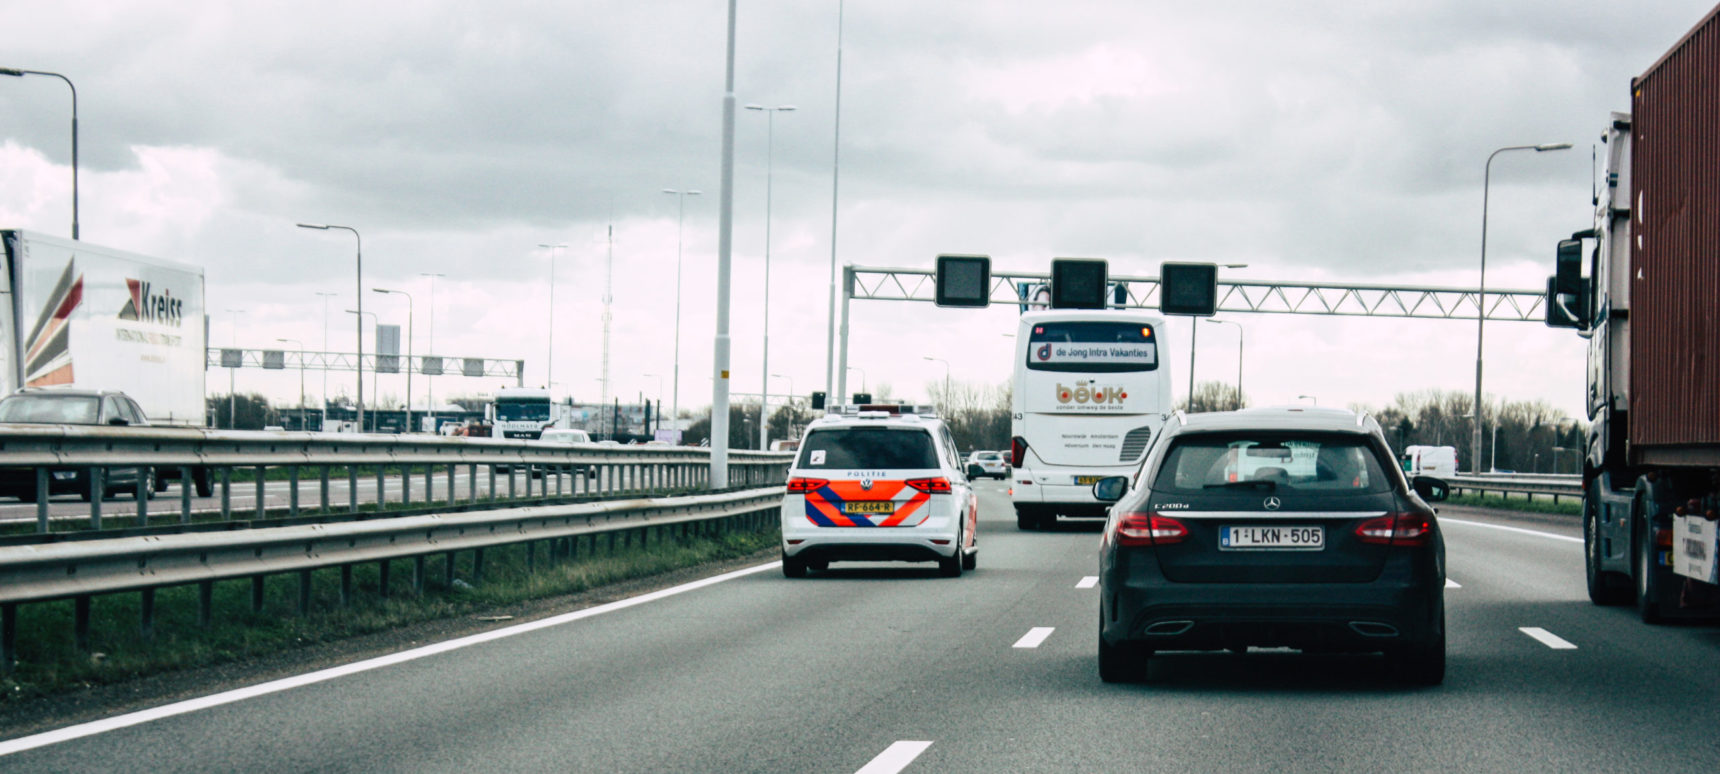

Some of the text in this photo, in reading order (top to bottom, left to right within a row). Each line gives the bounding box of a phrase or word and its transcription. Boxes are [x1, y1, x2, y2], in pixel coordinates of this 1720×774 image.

[141, 280, 183, 328] Kreiss
[1056, 347, 1148, 359] de Jong Intra Vakanties
[847, 503, 891, 512] RF-664-R
